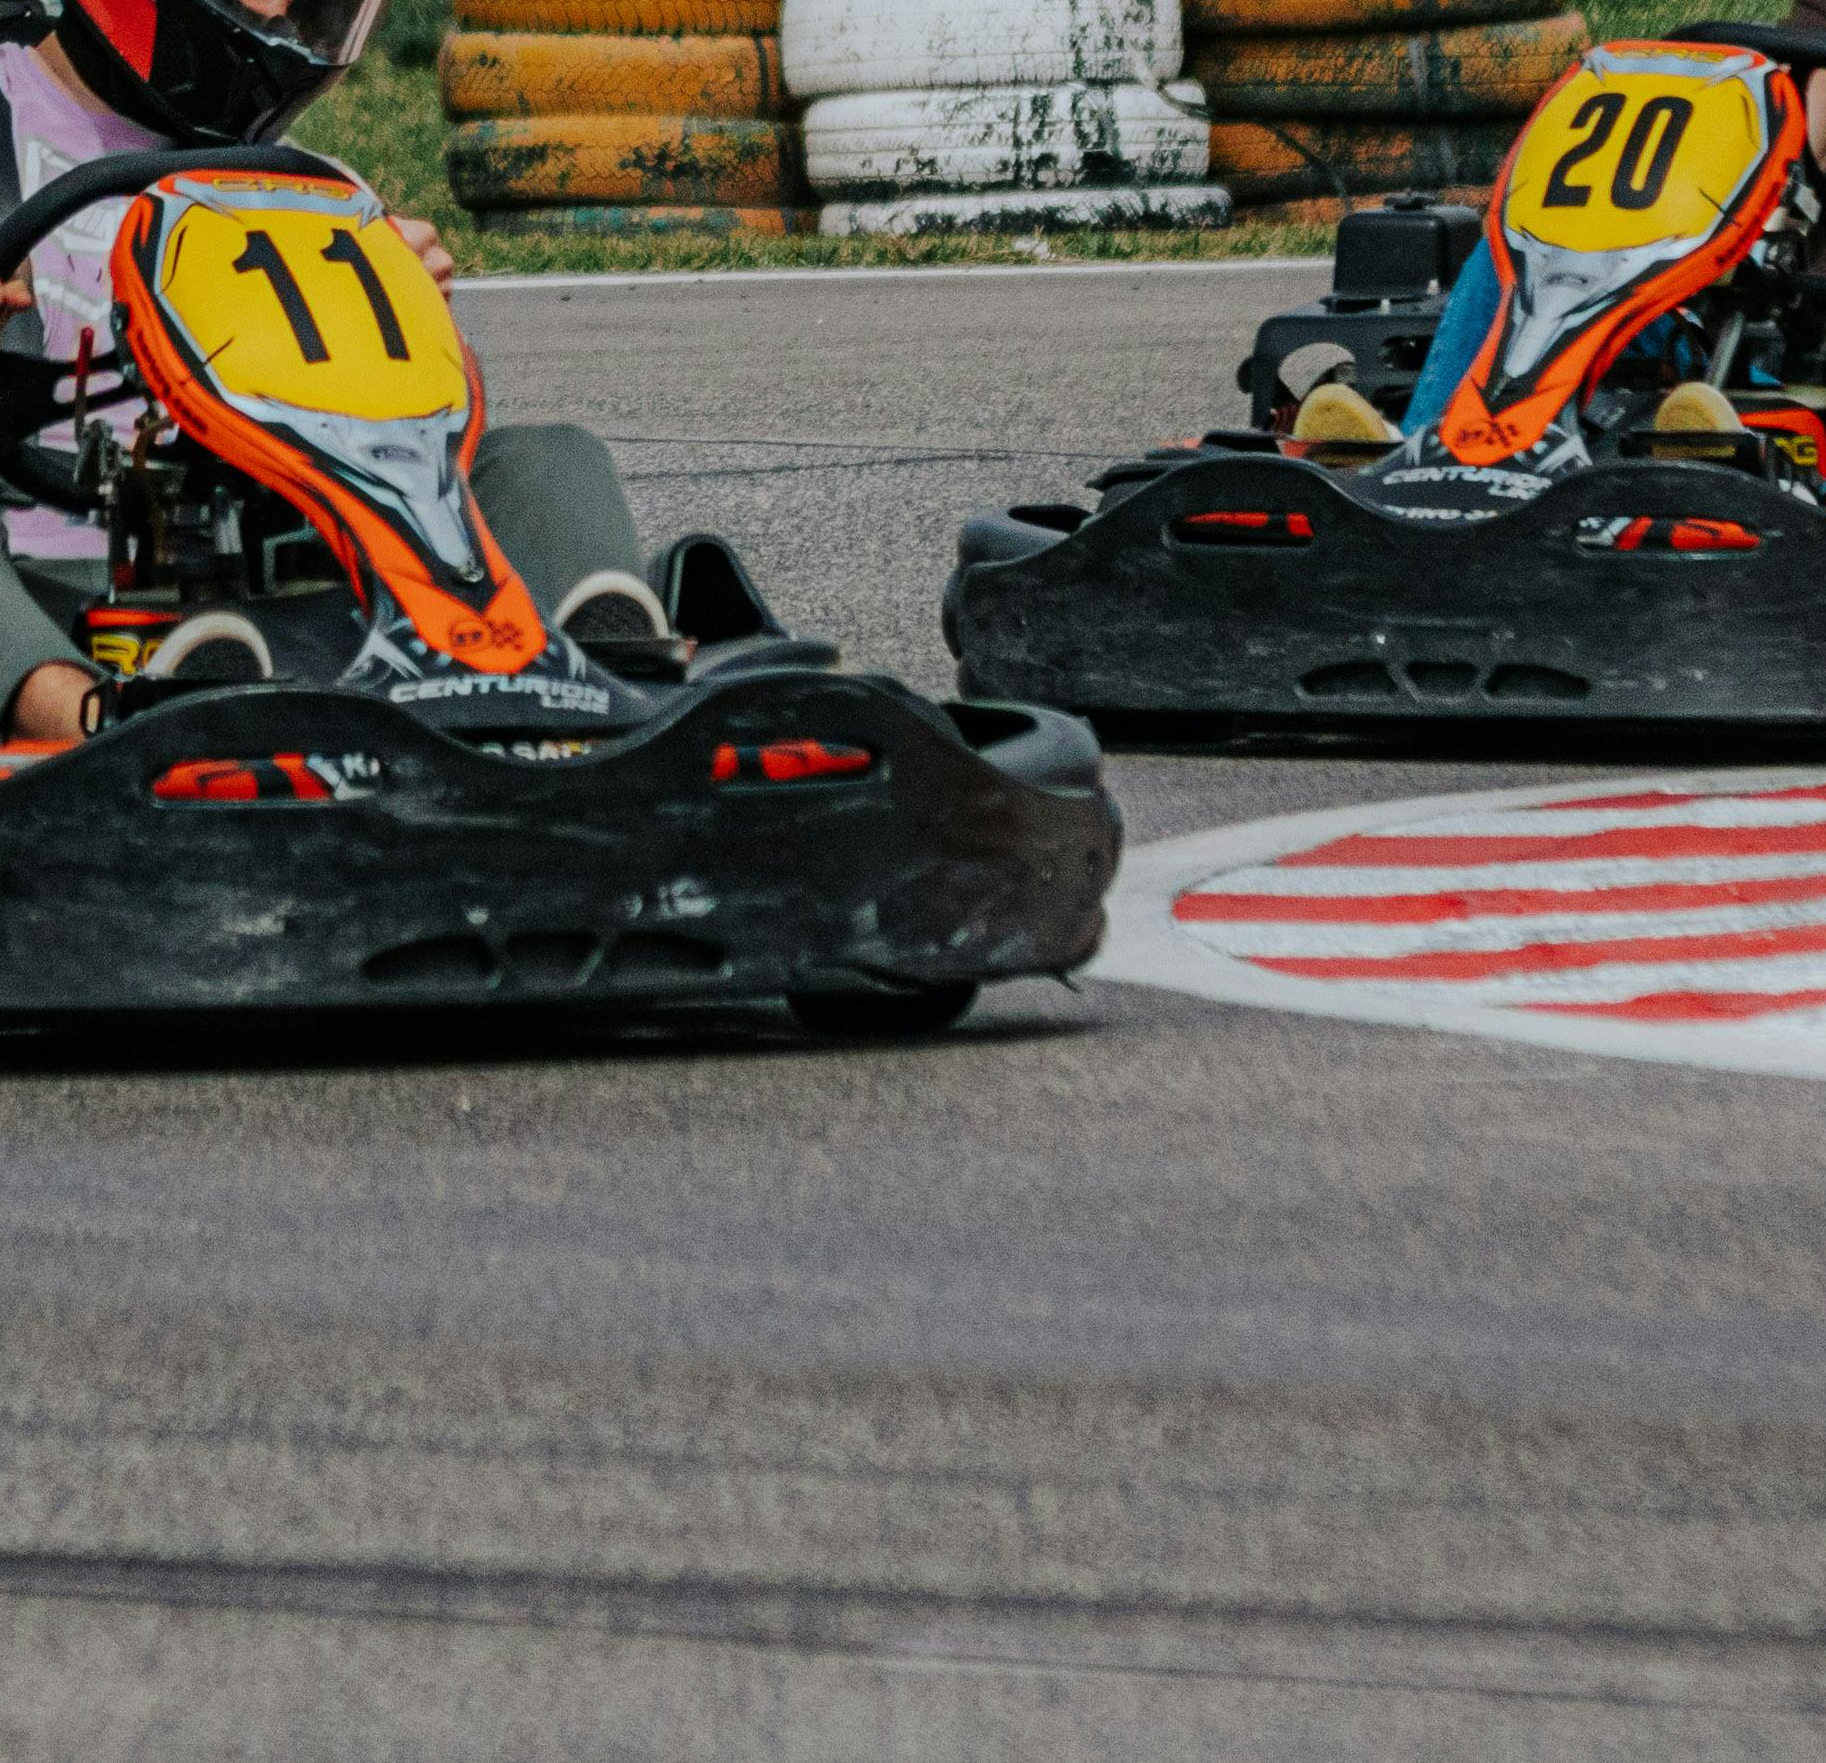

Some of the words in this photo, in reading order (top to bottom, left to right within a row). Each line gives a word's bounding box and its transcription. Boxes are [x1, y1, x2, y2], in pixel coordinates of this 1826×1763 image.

[1542, 93, 1693, 211] 20
[232, 229, 409, 363] 11
[389, 674, 610, 704] CENTURION
